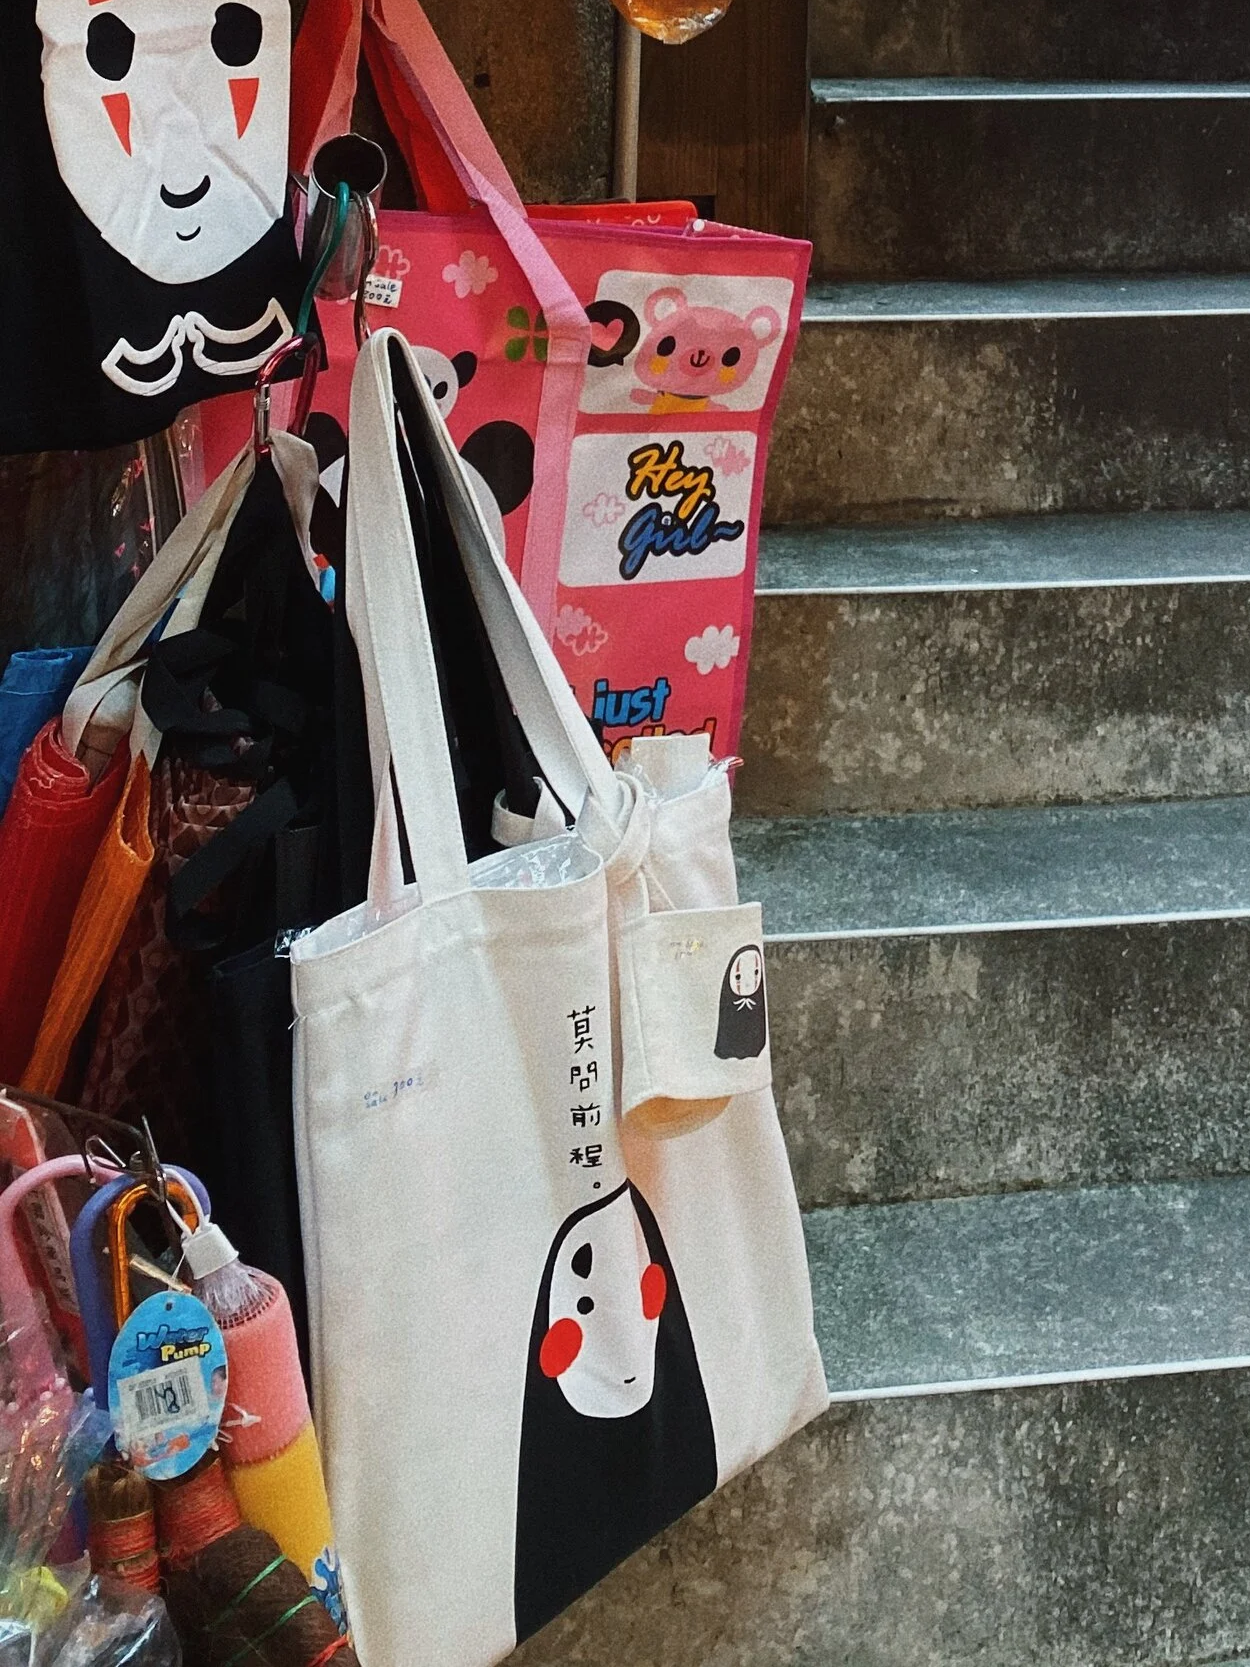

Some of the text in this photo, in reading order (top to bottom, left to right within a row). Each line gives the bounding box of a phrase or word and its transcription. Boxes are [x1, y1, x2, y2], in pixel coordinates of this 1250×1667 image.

[626, 440, 717, 524] Hey
[592, 678, 671, 727] just
[160, 1342, 212, 1364] Pump
